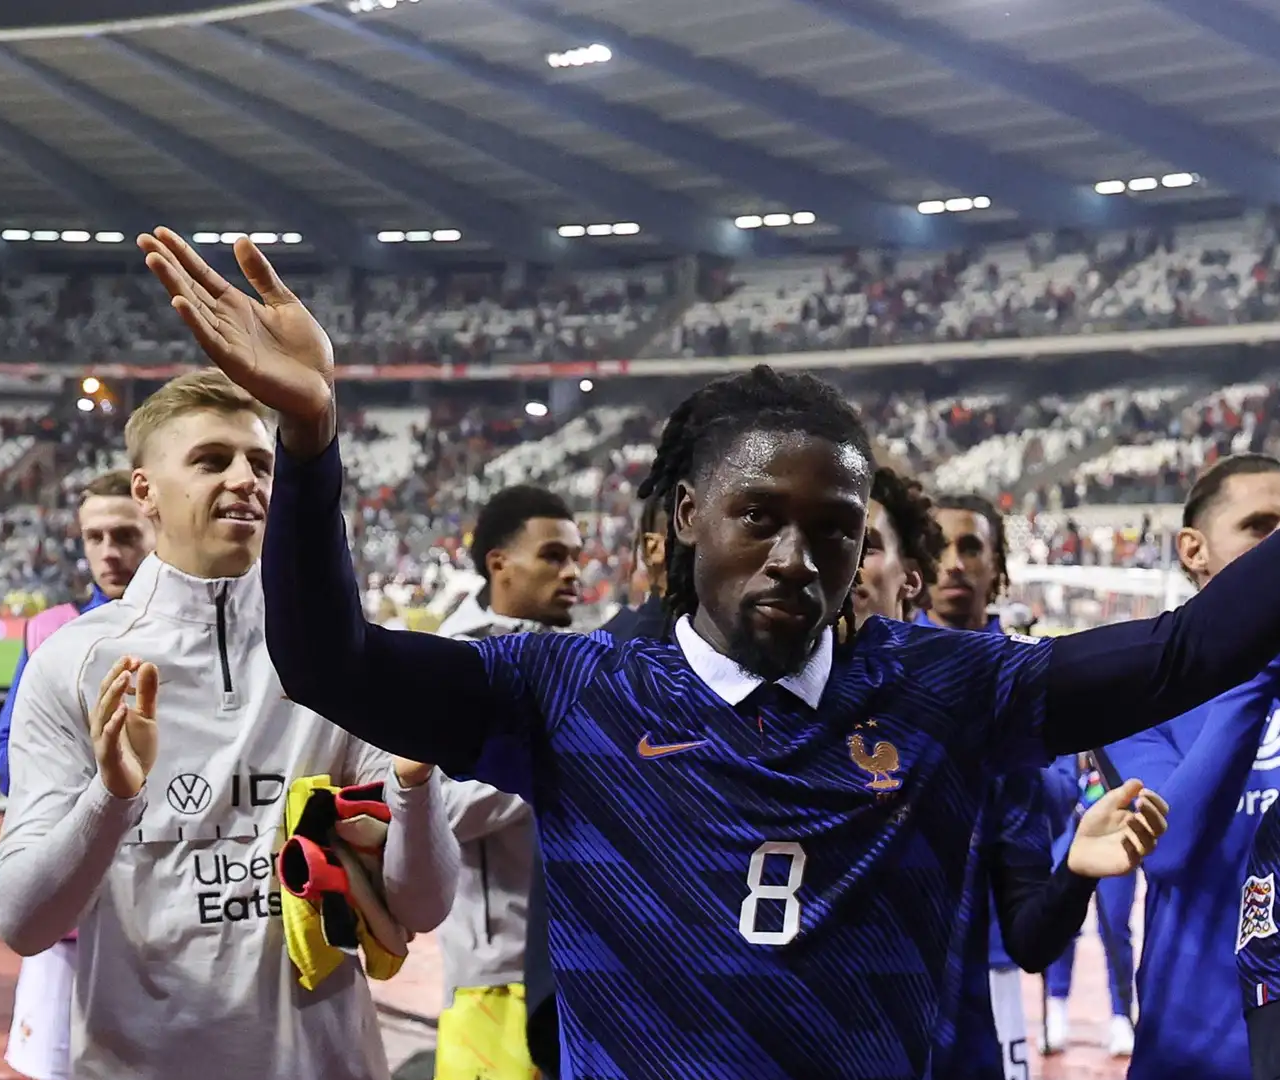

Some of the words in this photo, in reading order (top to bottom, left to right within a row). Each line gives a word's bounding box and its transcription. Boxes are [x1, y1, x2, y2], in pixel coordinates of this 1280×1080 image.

[231, 774, 286, 806] ID
[194, 853, 279, 885] Uber
[197, 889, 282, 924] Eats
[739, 841, 807, 945] 8
